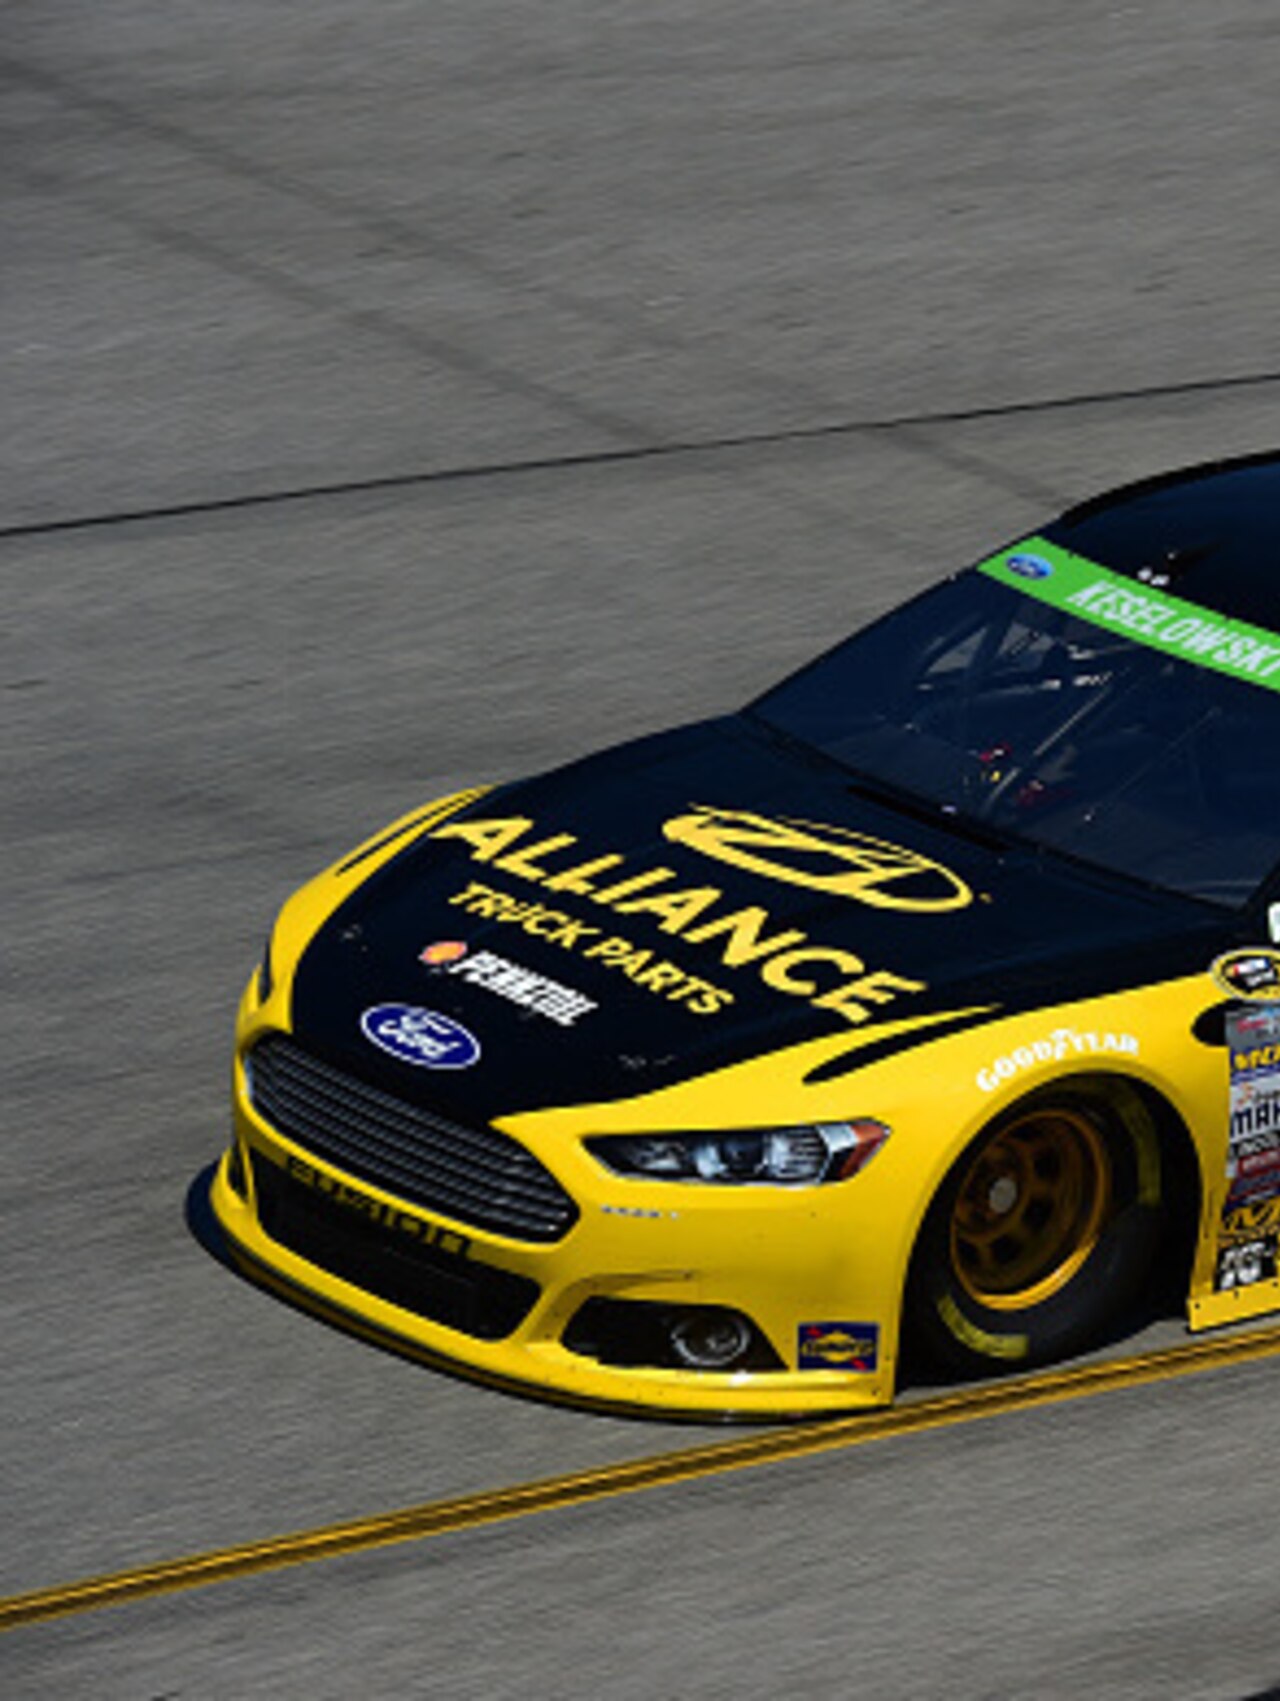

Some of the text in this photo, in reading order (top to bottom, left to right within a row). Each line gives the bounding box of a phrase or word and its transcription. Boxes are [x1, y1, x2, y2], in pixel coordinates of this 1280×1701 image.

[429, 814, 928, 1024] ALLIANCE
[449, 882, 735, 1014] TRUCK PARTS
[377, 1008, 463, 1059] Ford
[976, 1028, 1140, 1092] GOODYEAR
